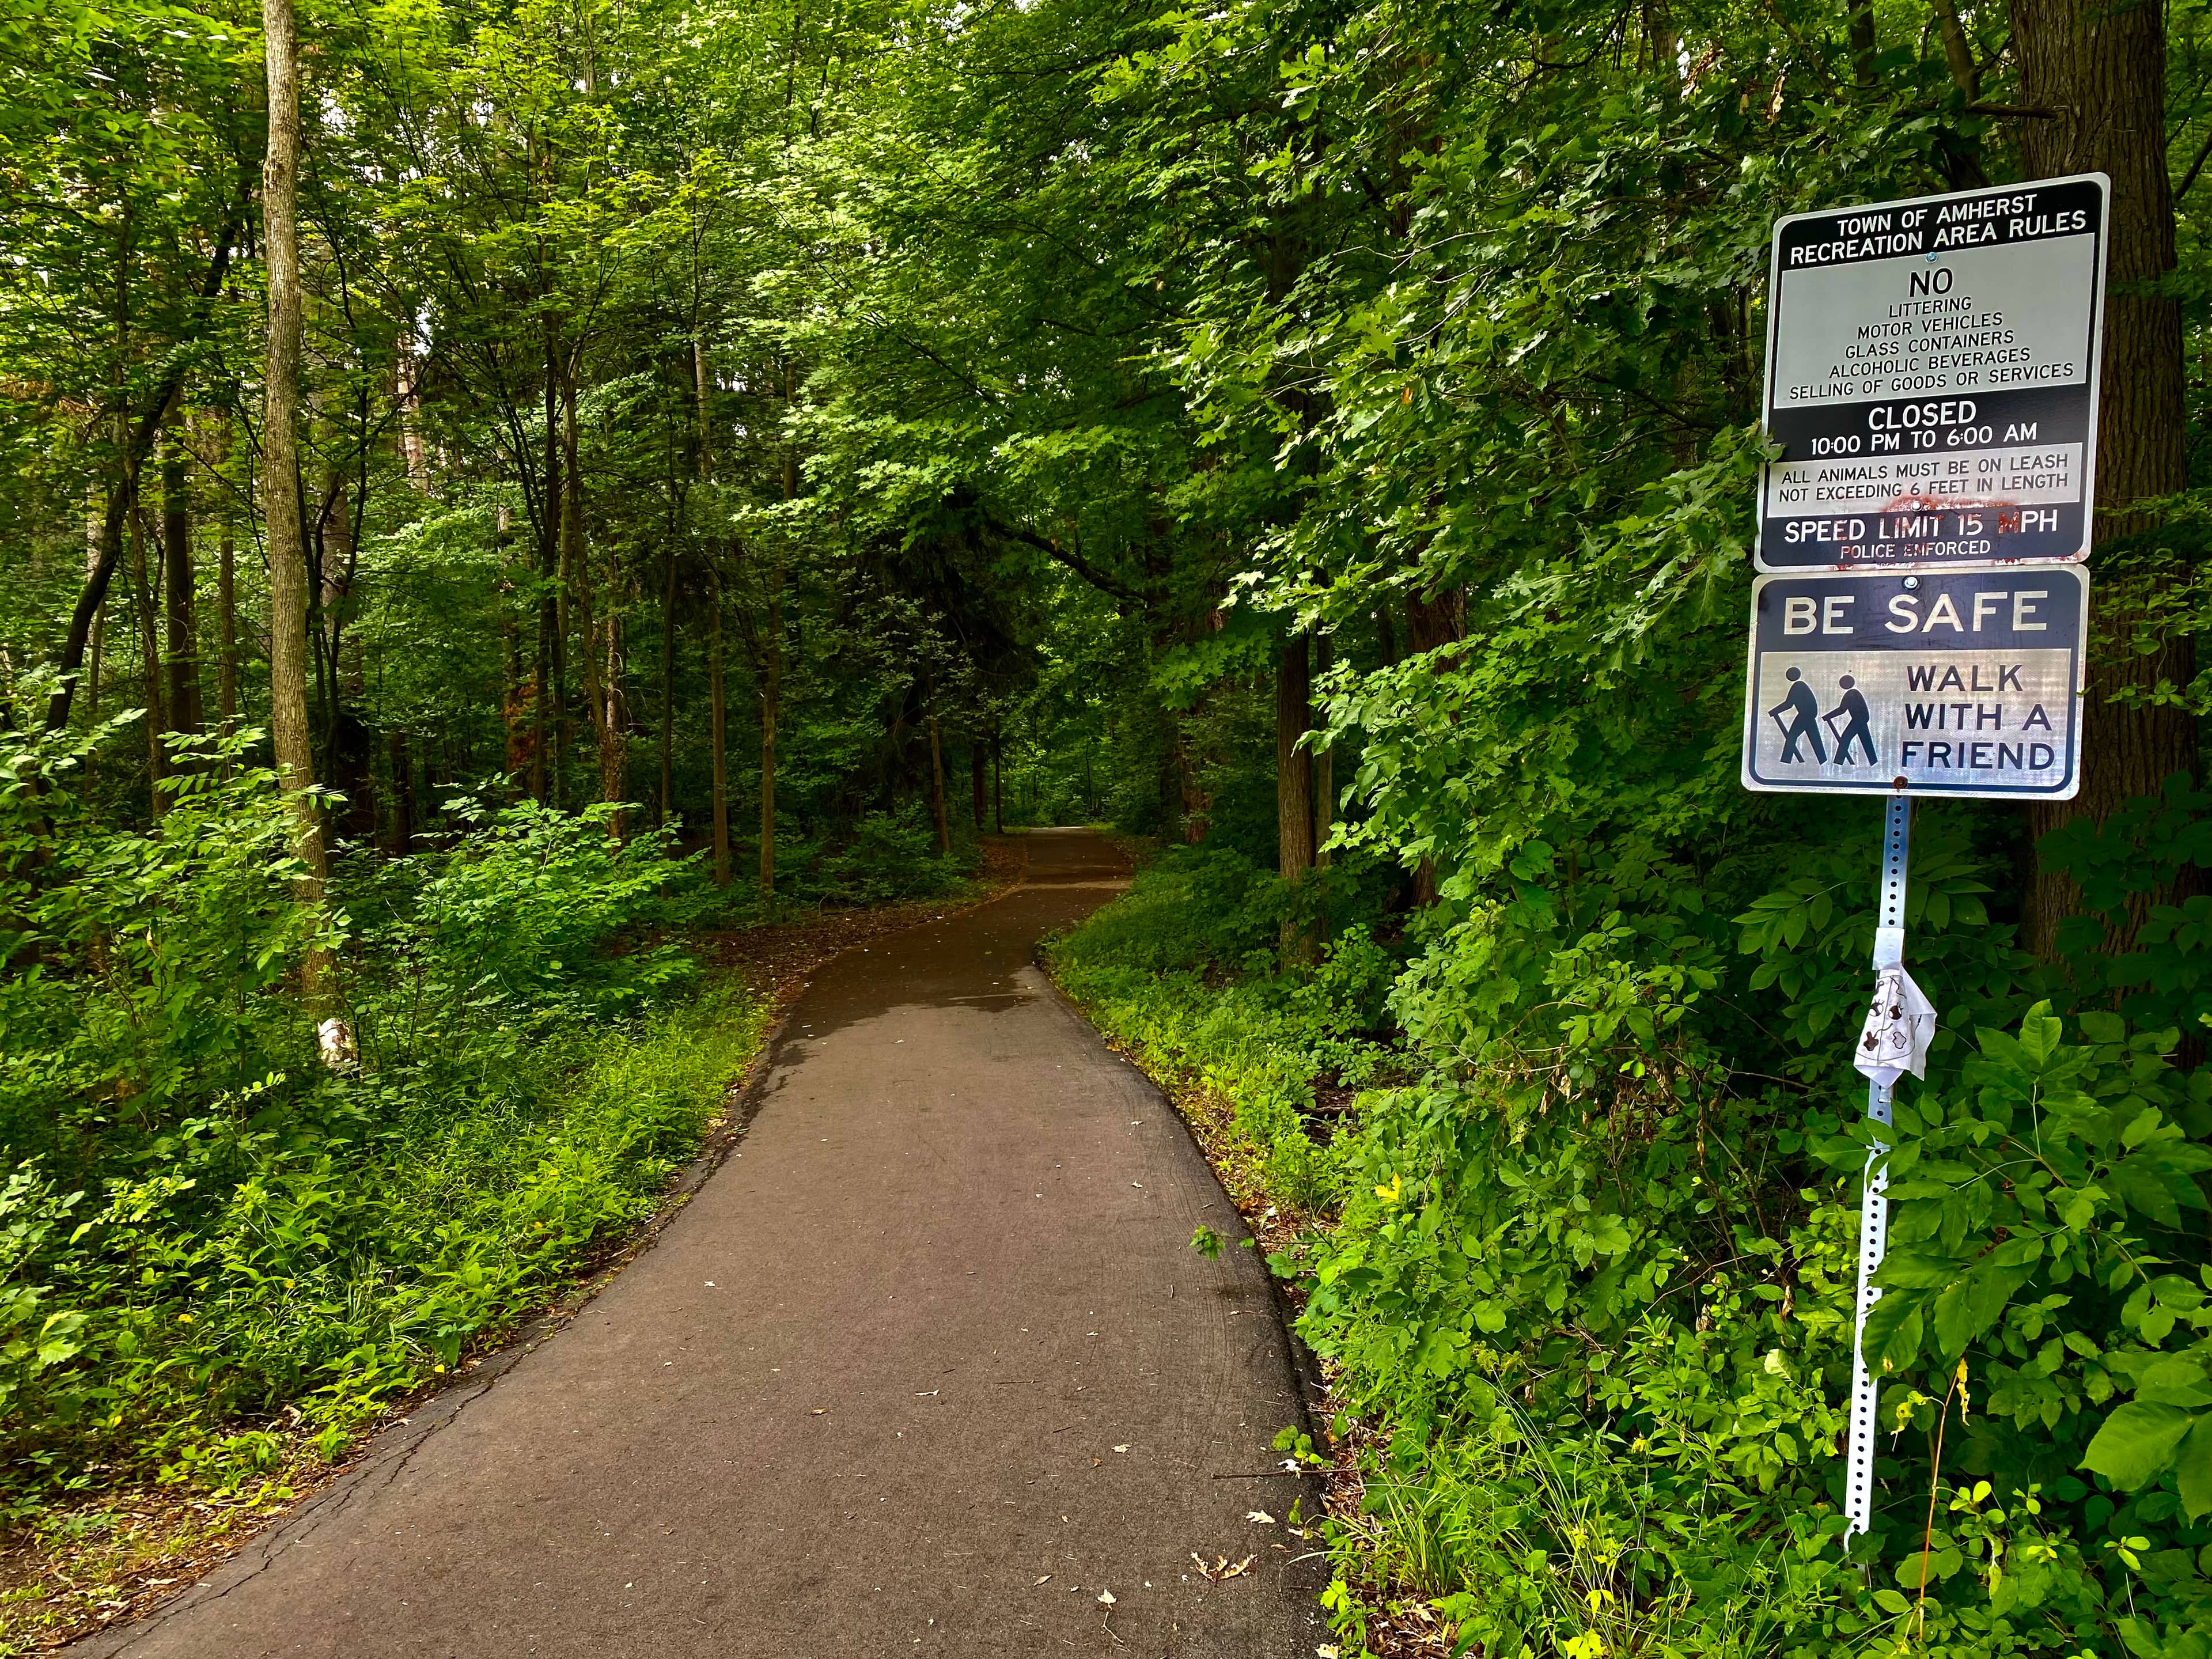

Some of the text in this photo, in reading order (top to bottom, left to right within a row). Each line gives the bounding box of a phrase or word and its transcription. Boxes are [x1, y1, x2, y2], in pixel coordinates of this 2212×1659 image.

[1837, 194, 2037, 237] TOWN OF AMHERST
[1790, 210, 2086, 265] RECREATION AREA RULES
[1909, 267, 1953, 298] NO
[1889, 297, 1972, 318] LITTERING
[1858, 312, 2003, 339] MOTOR VEHICLES
[1845, 330, 2014, 359] GLASS CONTAINERS
[1829, 348, 2031, 378] ALCOHOLIC BEVERAGES
[1790, 362, 2074, 400] SELLING OF GOODS OR SERVICES
[1868, 400, 1977, 431] CLOSED
[1811, 422, 2037, 455] 10:00 PM TO 6:00 AM
[1782, 453, 2069, 484] ALL ANIMALS MUST BE ON LEASH
[1779, 473, 2069, 502] NOT EXCEEDING 6 FEET IN LENGTH
[1784, 509, 2058, 543] SPEED LIMIT 15 MPH
[1840, 540, 1991, 559] POLICE ENFORCED
[1784, 590, 2048, 635] BE SAFE
[1907, 664, 2023, 692] WALK
[1905, 703, 2052, 731] WITH A
[1902, 741, 2055, 771] FRIEND
